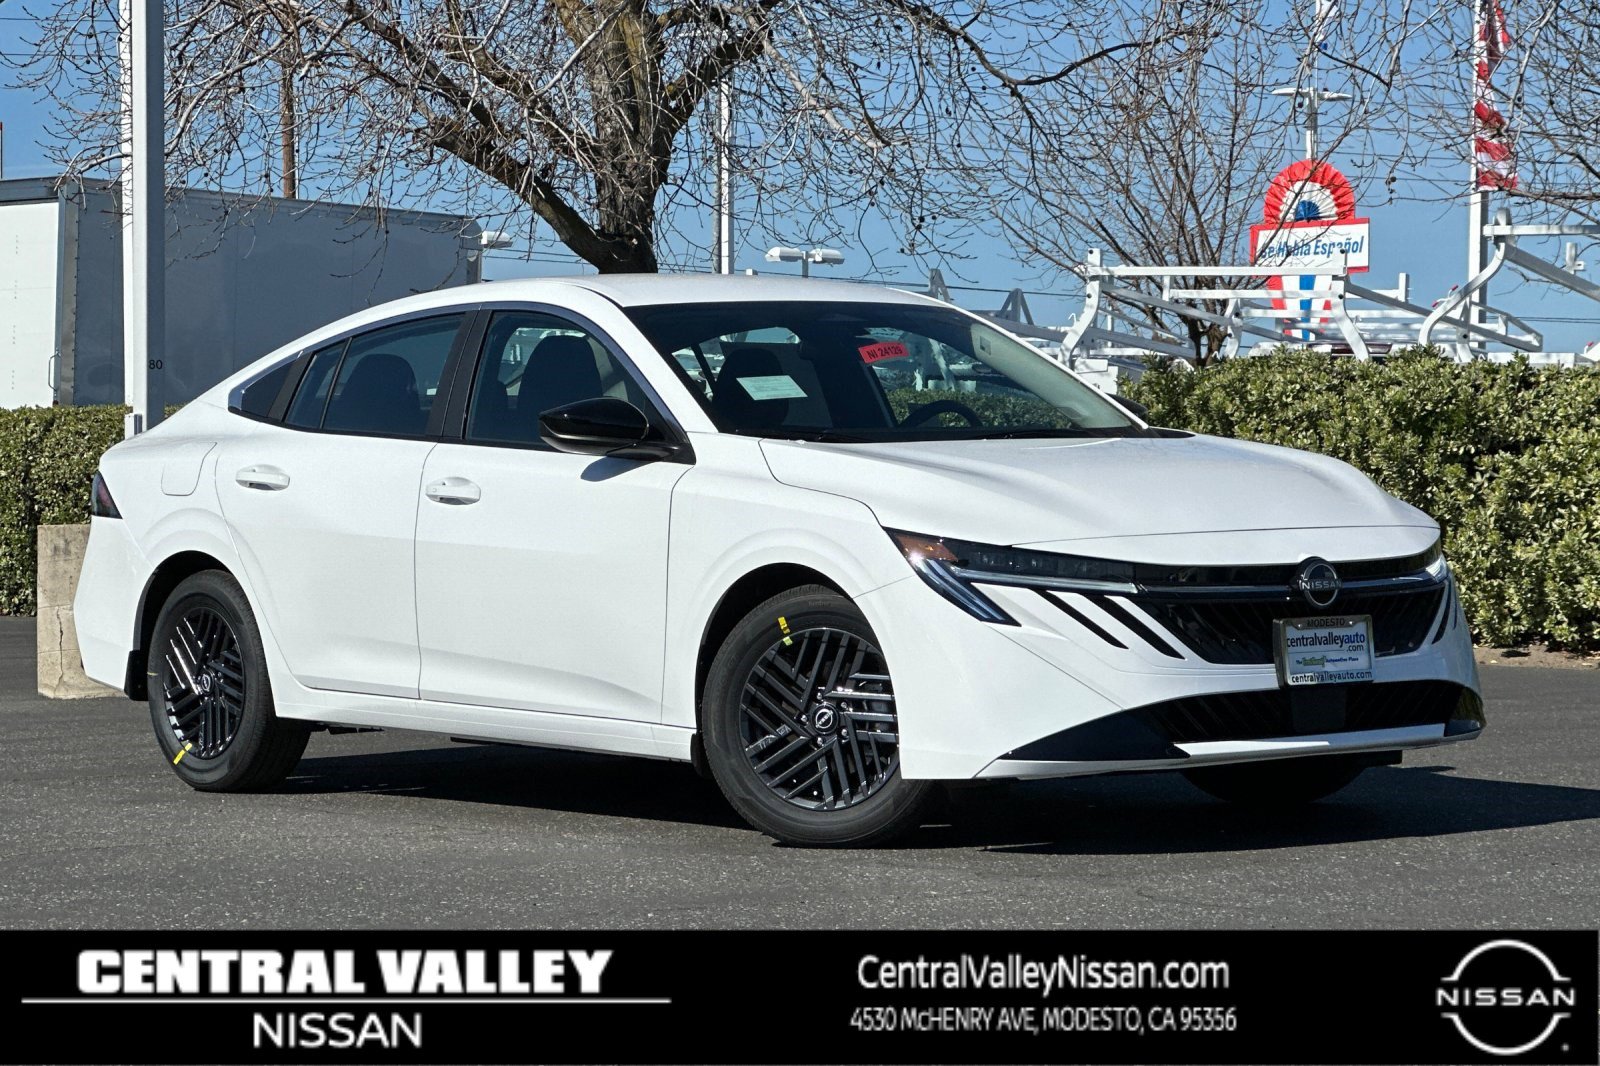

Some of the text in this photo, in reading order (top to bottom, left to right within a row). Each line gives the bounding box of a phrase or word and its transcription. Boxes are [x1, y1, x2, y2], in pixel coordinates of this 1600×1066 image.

[148, 359, 163, 370] 80
[1302, 580, 1342, 590] NISSAN
[1307, 617, 1345, 628] MODESTO
[1287, 632, 1365, 648] centralvalleyauto
[1291, 670, 1373, 684] centralvalleyauto.com
